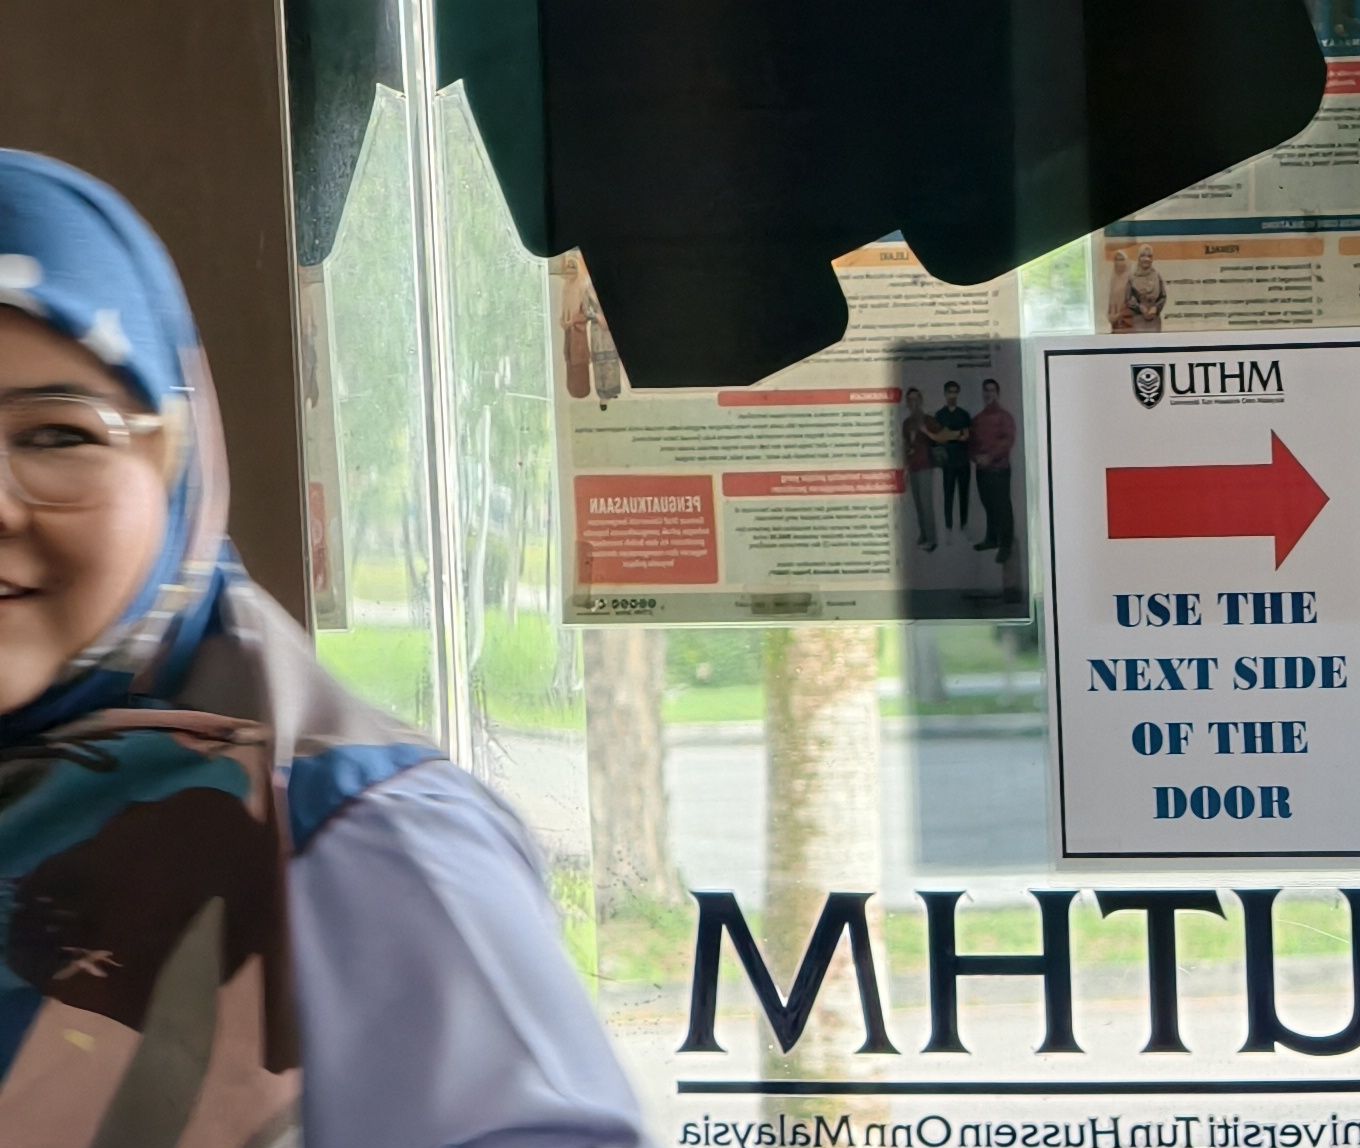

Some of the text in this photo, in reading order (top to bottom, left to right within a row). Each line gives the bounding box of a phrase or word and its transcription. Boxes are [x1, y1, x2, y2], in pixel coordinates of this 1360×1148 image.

[1169, 360, 1284, 395] UTHM
[1113, 591, 1318, 628] USE THE
[1087, 655, 1348, 692] NEXT SIDE
[1131, 720, 1309, 756] OF THE
[1153, 785, 1293, 820] DOOR
